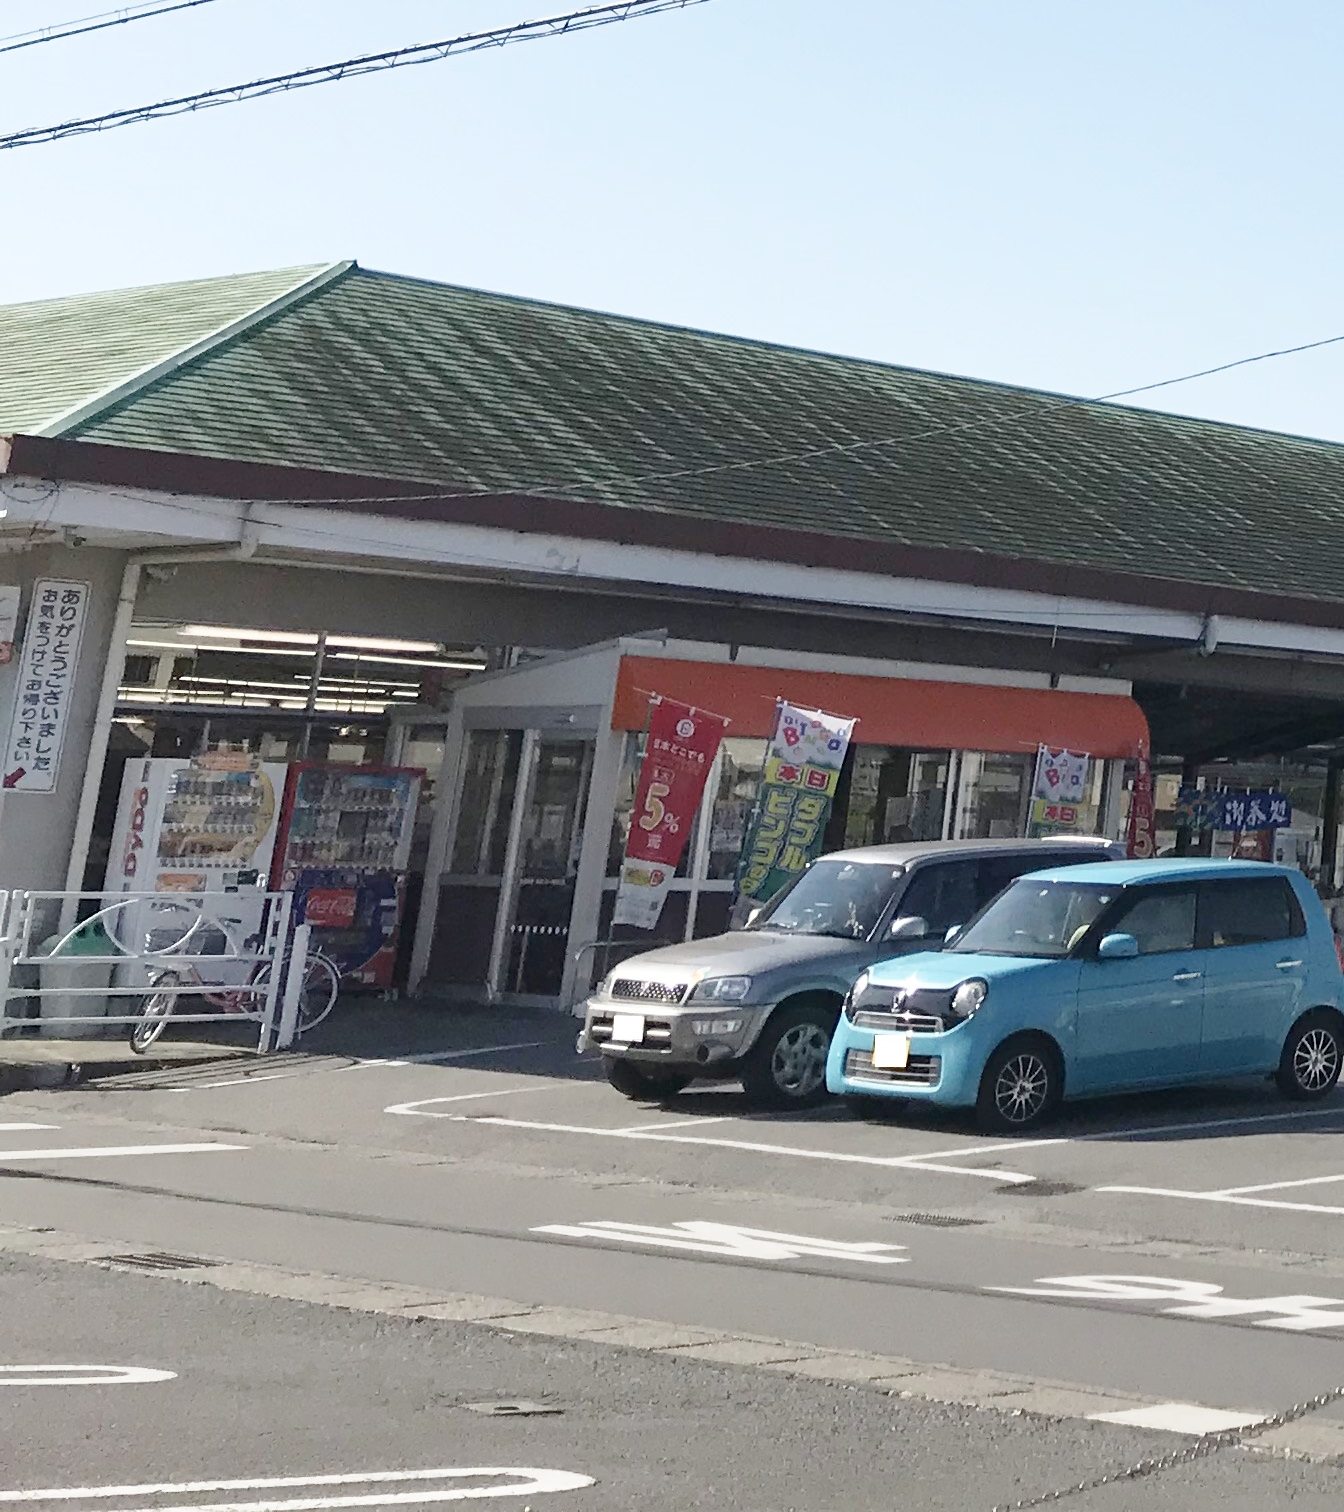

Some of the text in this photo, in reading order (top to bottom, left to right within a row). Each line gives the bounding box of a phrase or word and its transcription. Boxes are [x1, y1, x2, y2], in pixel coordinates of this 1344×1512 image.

[14, 588, 59, 762] お気をつけてお帰り下さい
[777, 763, 830, 791] 本日
